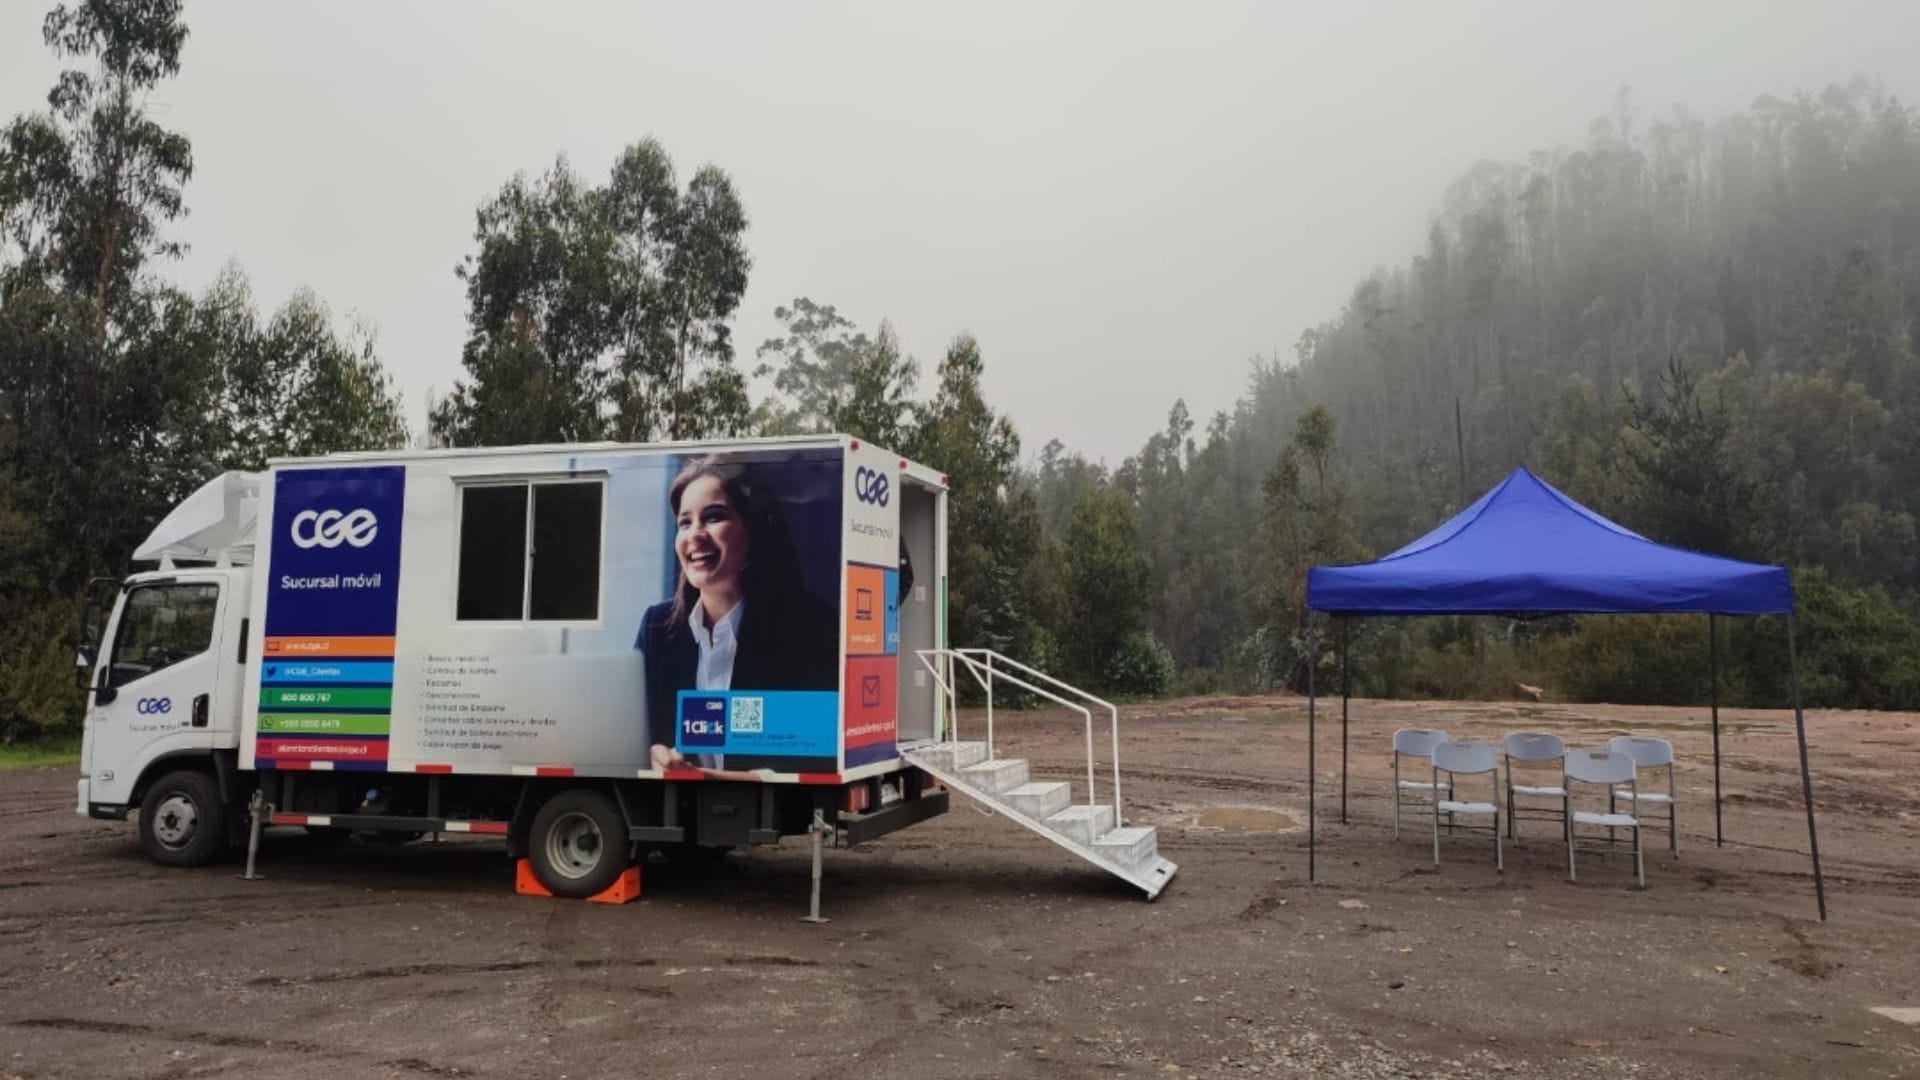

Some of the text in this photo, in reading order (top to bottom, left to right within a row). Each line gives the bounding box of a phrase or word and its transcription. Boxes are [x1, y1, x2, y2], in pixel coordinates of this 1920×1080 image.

[281, 573, 381, 589] Sucursal móvil
[281, 693, 298, 702] 800
[299, 693, 316, 702] 800
[683, 719, 724, 735] 1Click
